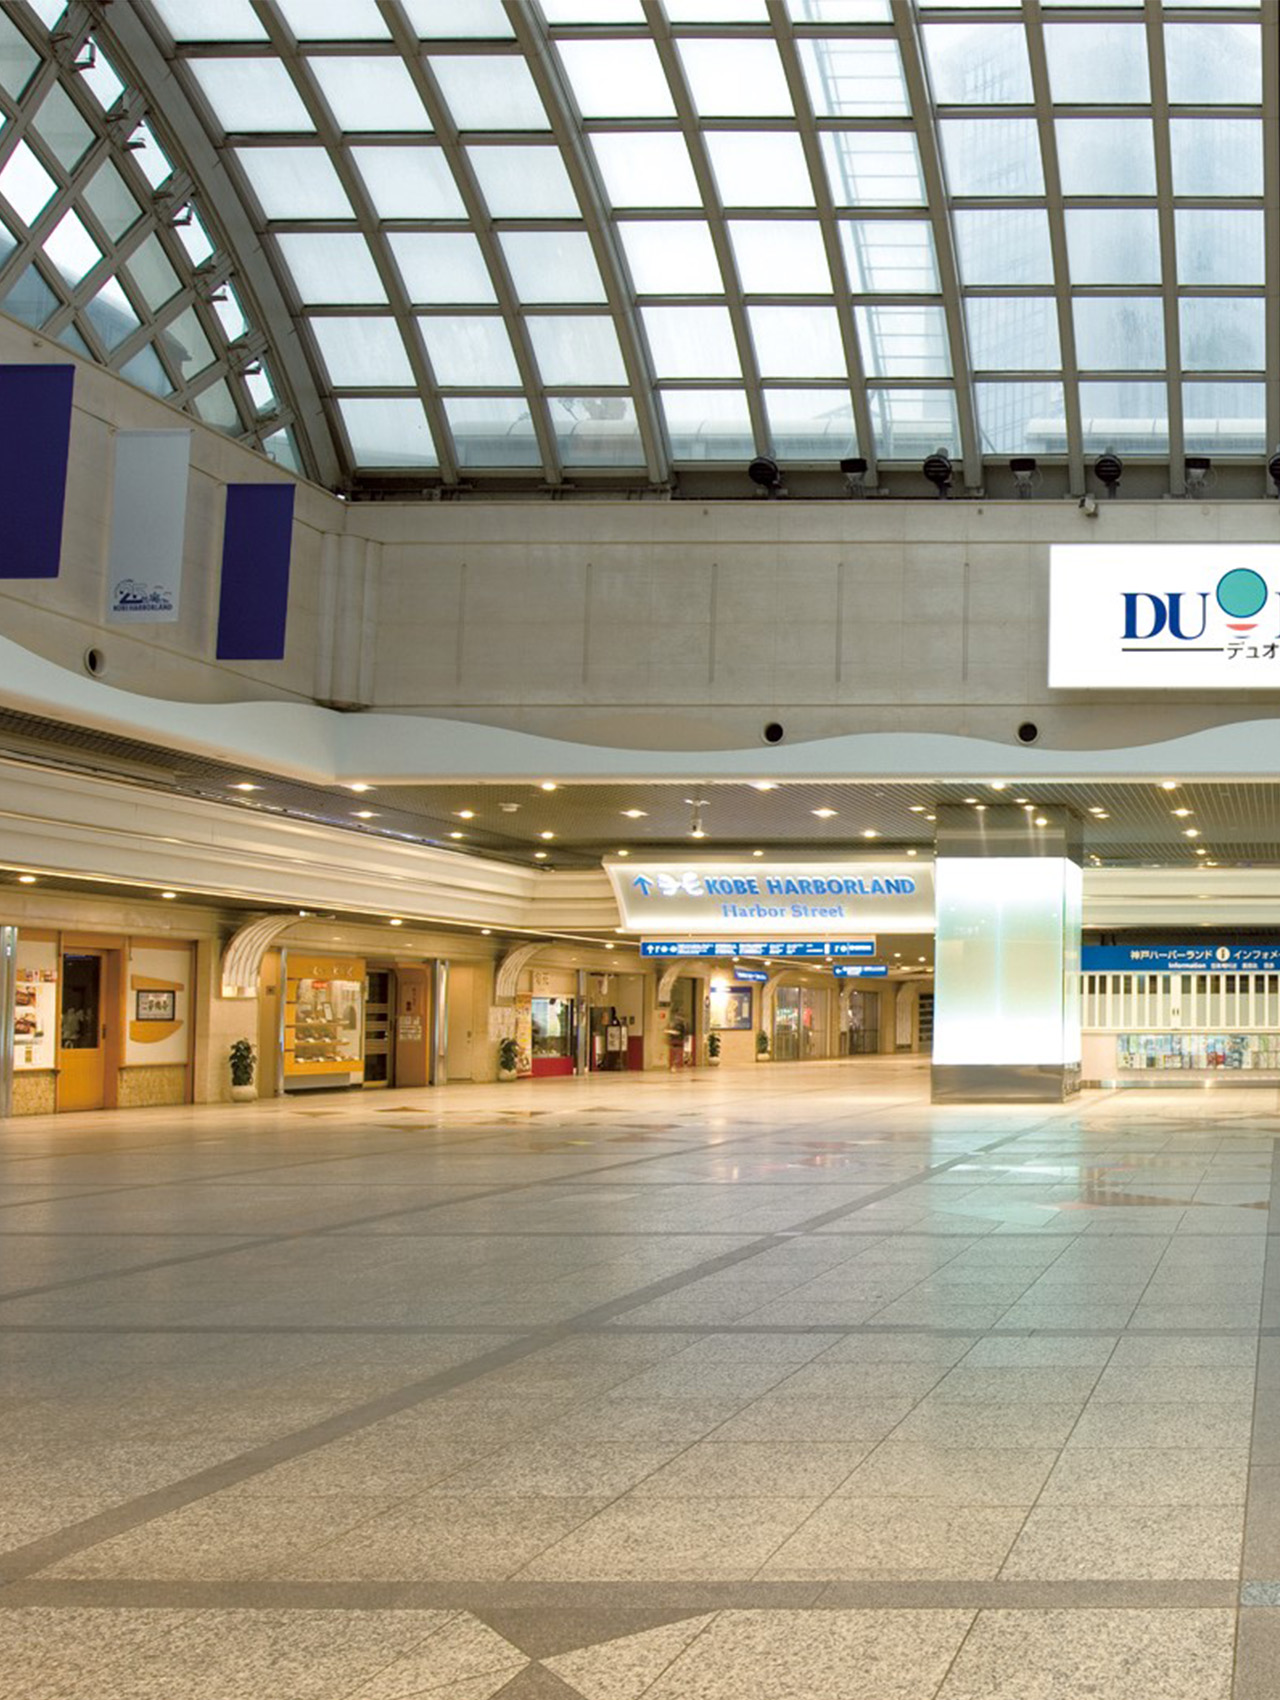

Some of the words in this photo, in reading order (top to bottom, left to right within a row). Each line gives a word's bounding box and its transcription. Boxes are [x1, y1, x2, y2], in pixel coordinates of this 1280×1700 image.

[704, 876, 760, 896] KOBE
[767, 874, 917, 896] HARBORLAND
[722, 904, 787, 919] Harbor
[791, 904, 845, 918] Street
[1130, 949, 1213, 960] 神戸ハーバーランド
